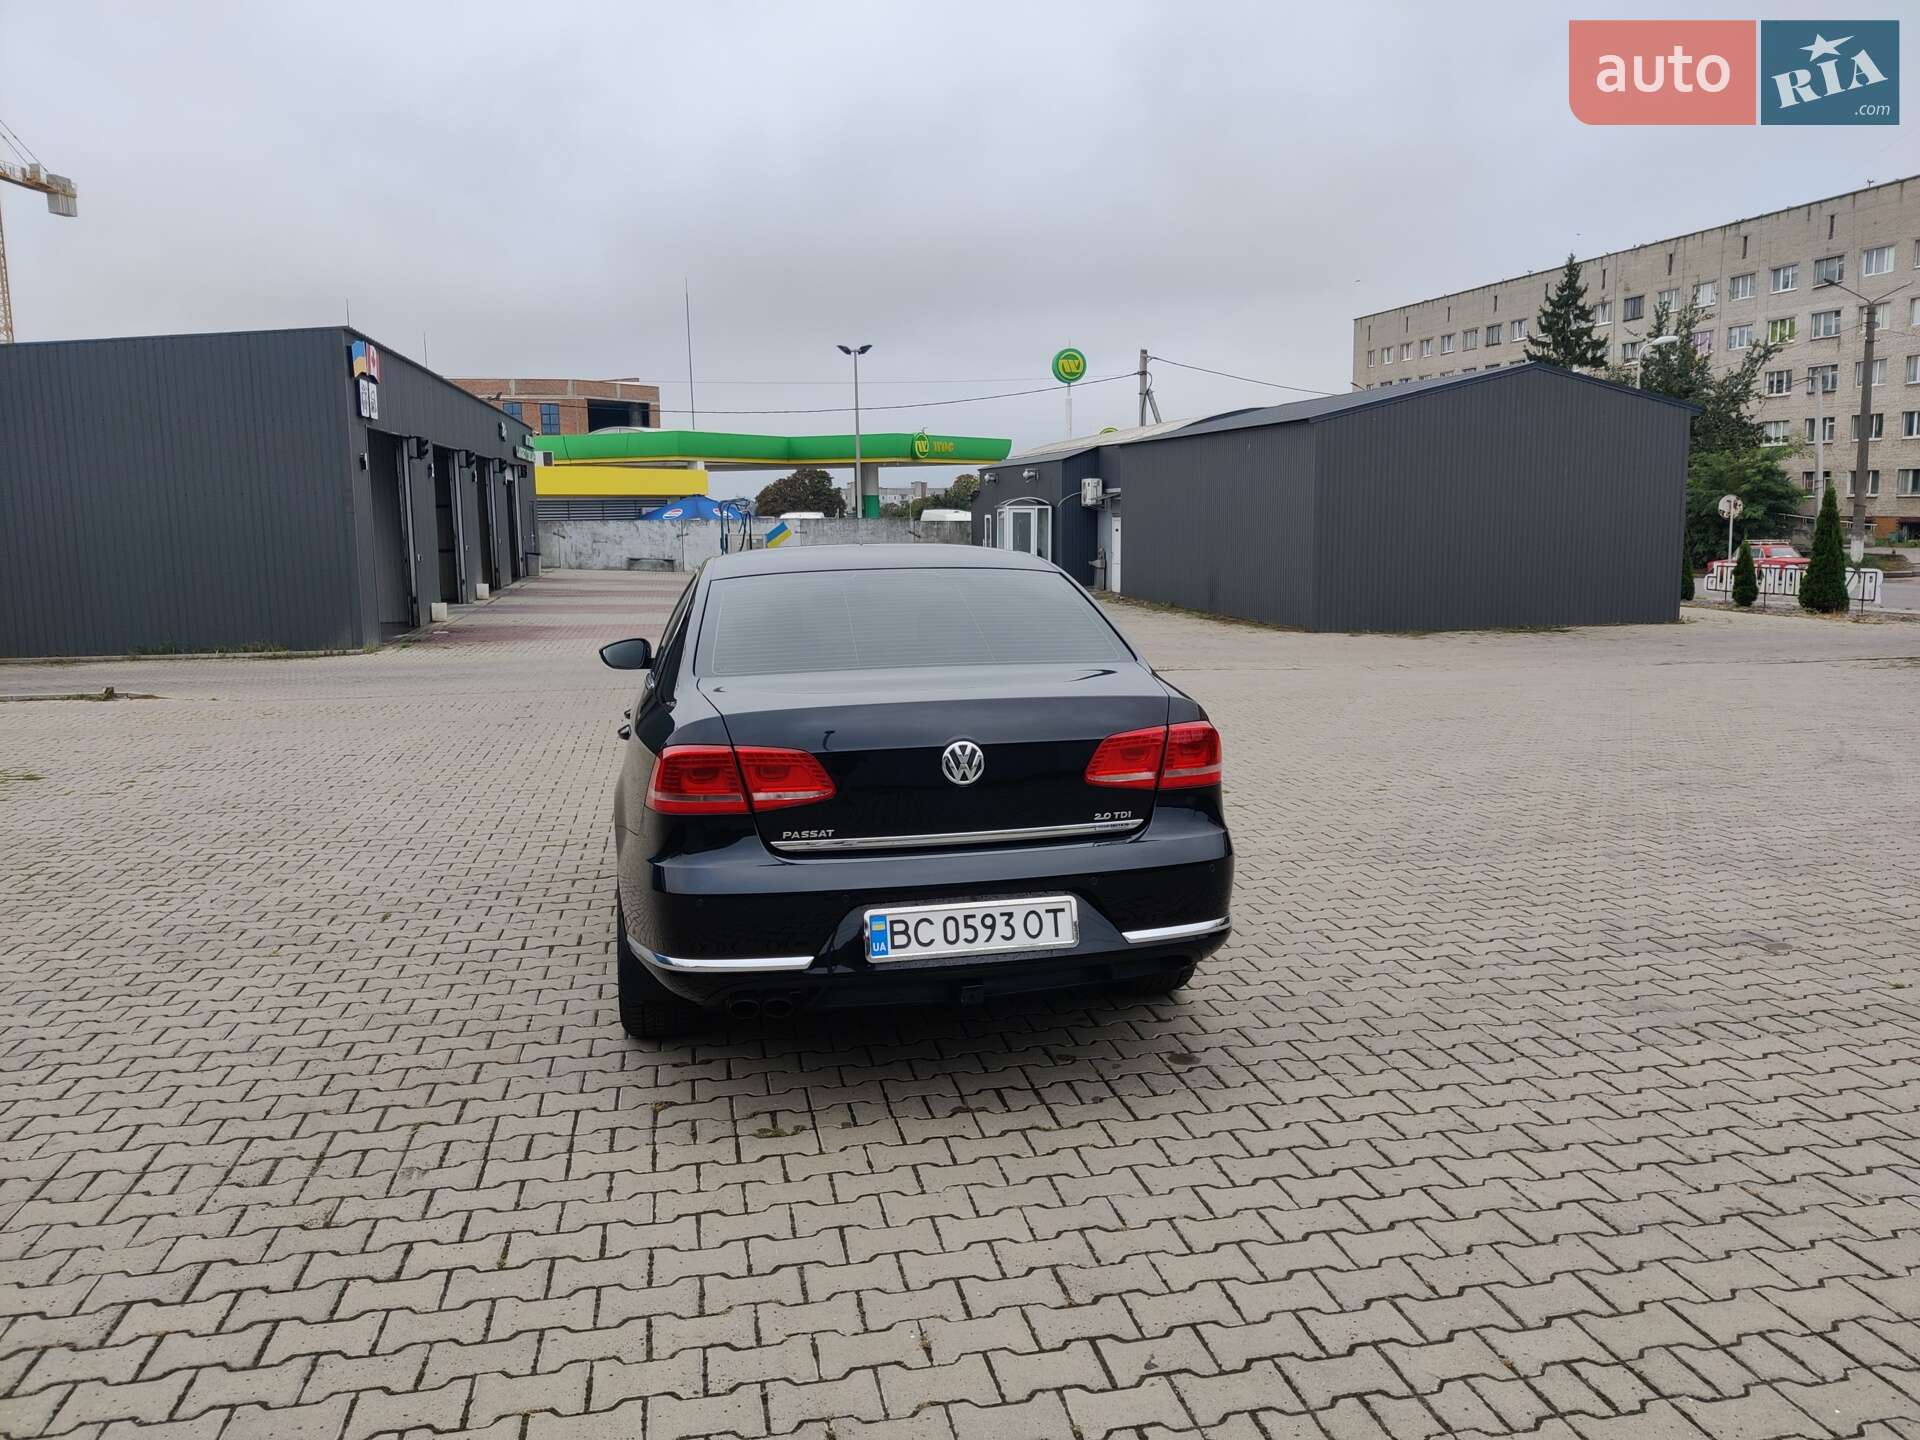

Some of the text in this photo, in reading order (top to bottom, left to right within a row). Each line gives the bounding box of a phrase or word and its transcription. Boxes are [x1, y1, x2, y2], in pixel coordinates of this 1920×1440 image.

[1113, 811, 1132, 819] TDI
[783, 829, 835, 839] PASSAT
[889, 908, 1066, 950] BC 0593 OT
[873, 942, 887, 953] UA
